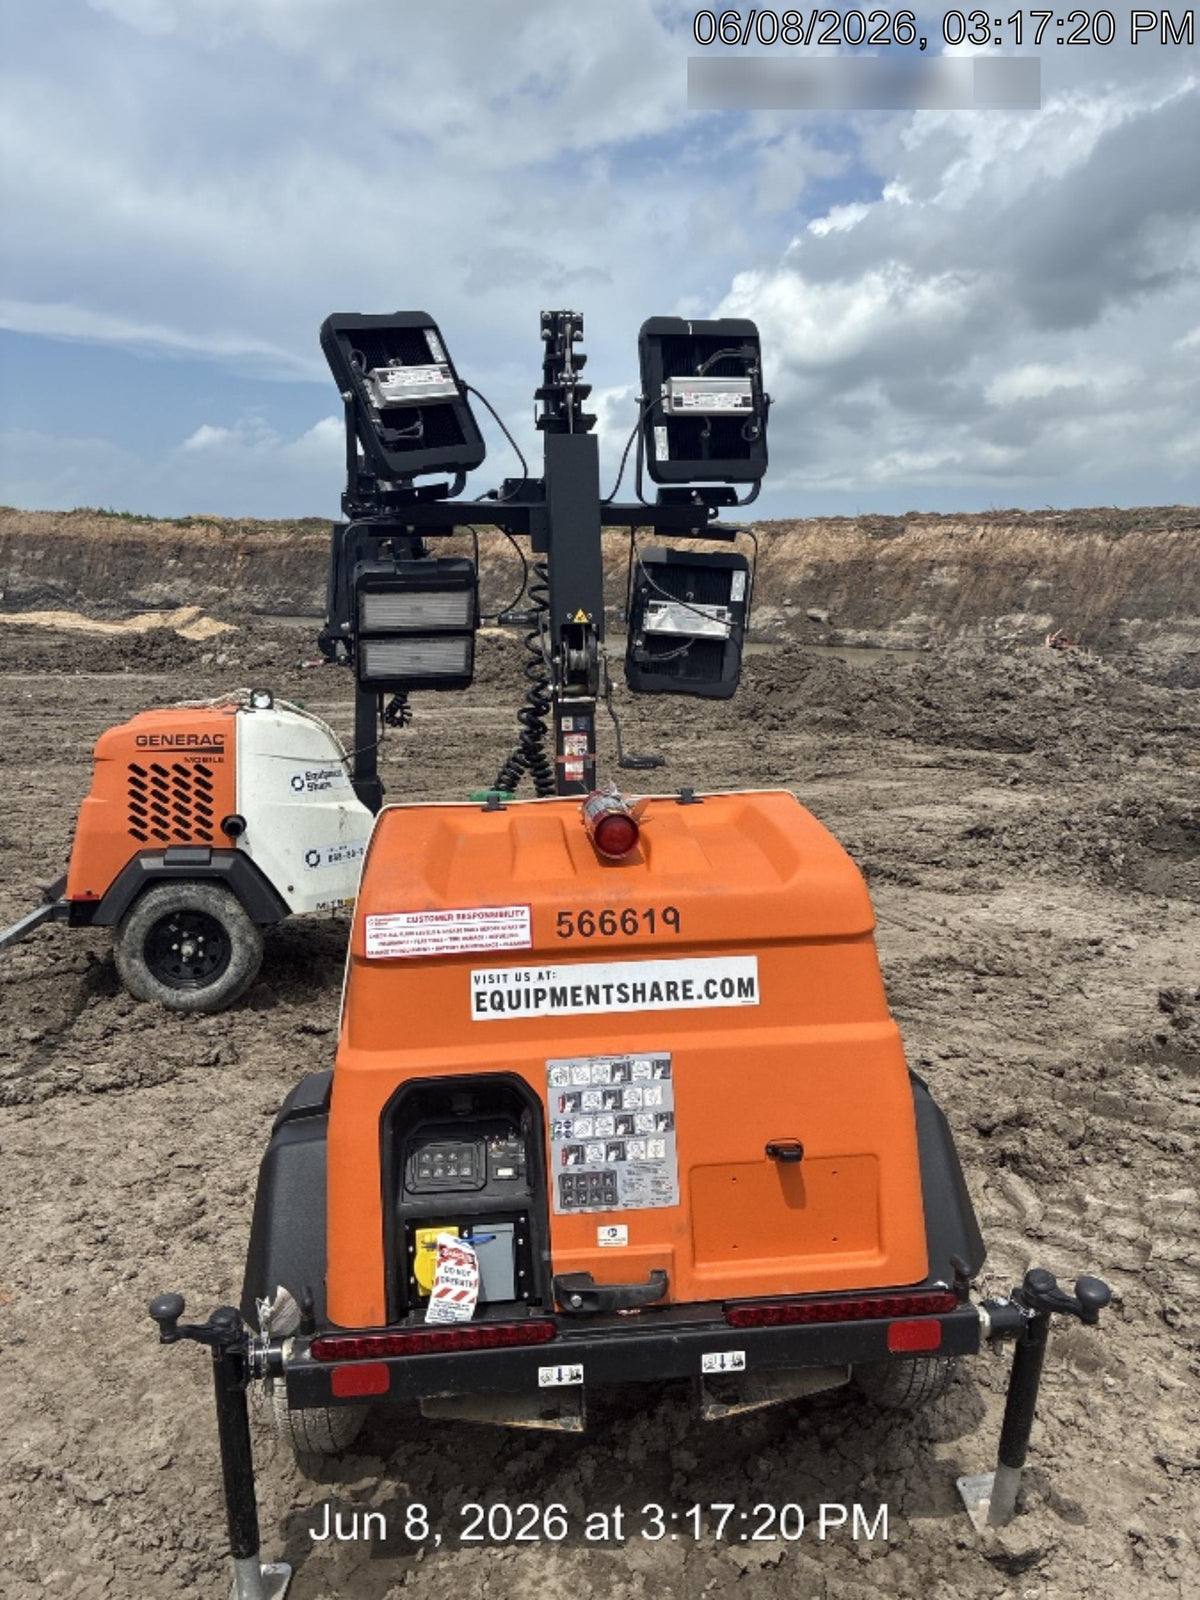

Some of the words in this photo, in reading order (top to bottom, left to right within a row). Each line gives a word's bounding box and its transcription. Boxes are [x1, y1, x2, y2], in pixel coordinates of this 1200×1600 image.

[136, 733, 225, 747] GENERAC
[183, 756, 225, 764] MOBILE
[406, 913, 454, 924] CUSTOMER
[456, 909, 526, 920] RESPONSIBILITY
[556, 906, 681, 938] 566619
[474, 973, 508, 985] VISIT
[515, 971, 531, 982] US
[537, 970, 556, 981] AT:
[475, 976, 755, 1013] EQUIPMENTSHARE.COM
[444, 1265, 456, 1275] DO
